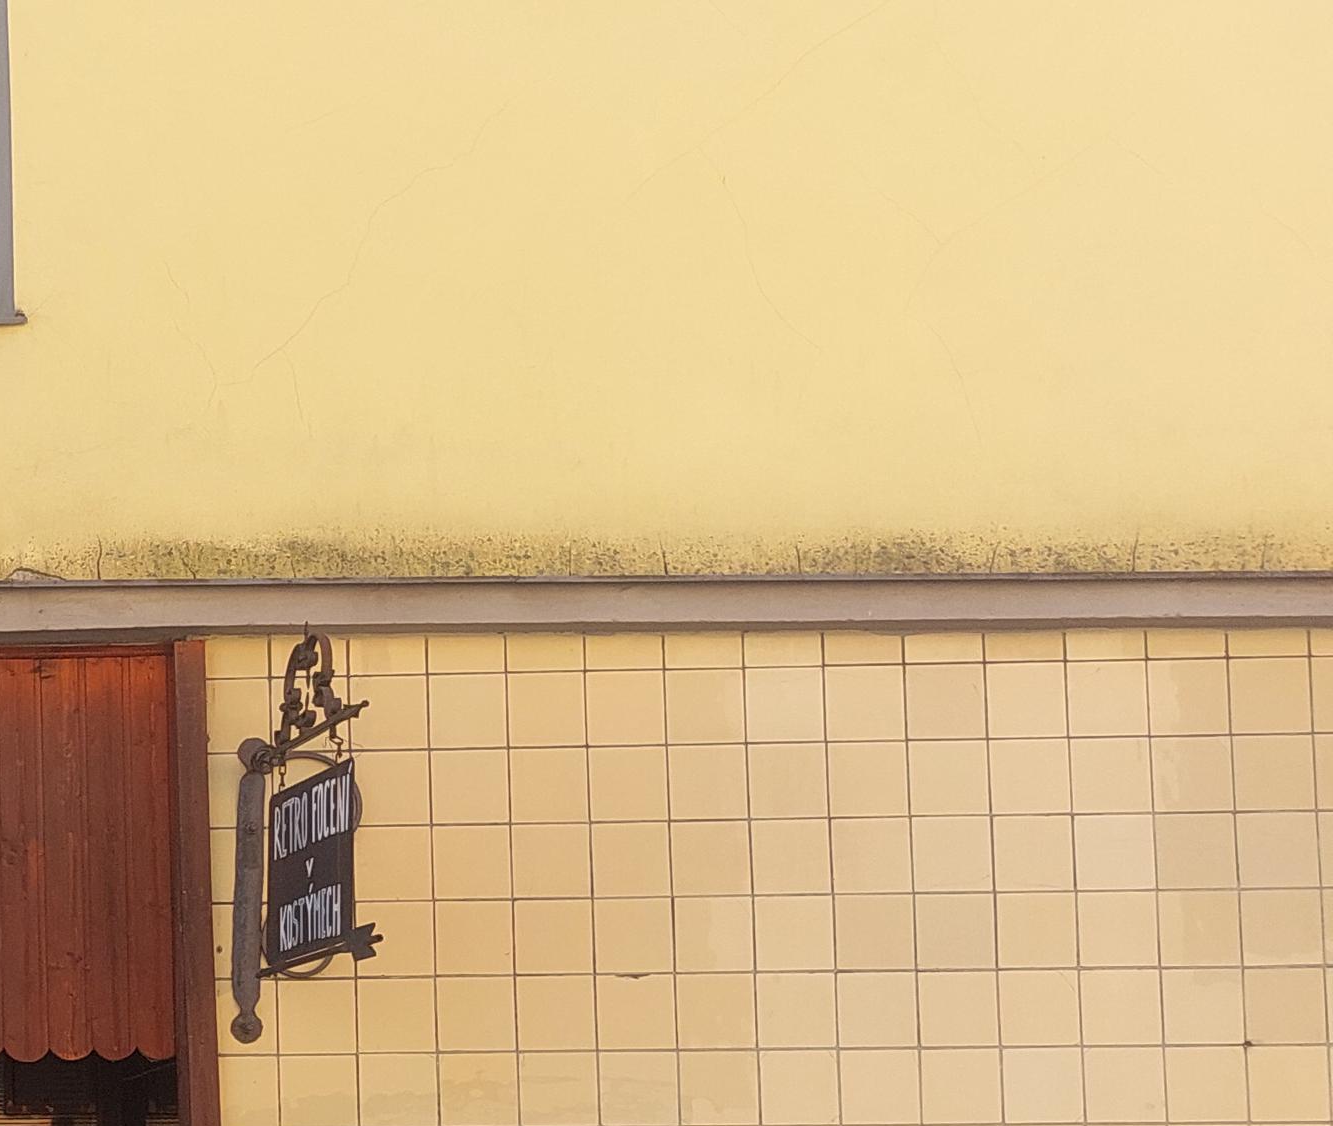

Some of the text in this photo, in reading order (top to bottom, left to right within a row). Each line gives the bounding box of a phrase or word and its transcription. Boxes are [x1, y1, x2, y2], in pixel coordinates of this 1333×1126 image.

[274, 761, 353, 862] RETRO FOCENÍ
[279, 882, 342, 953] KOSTÝMECH
